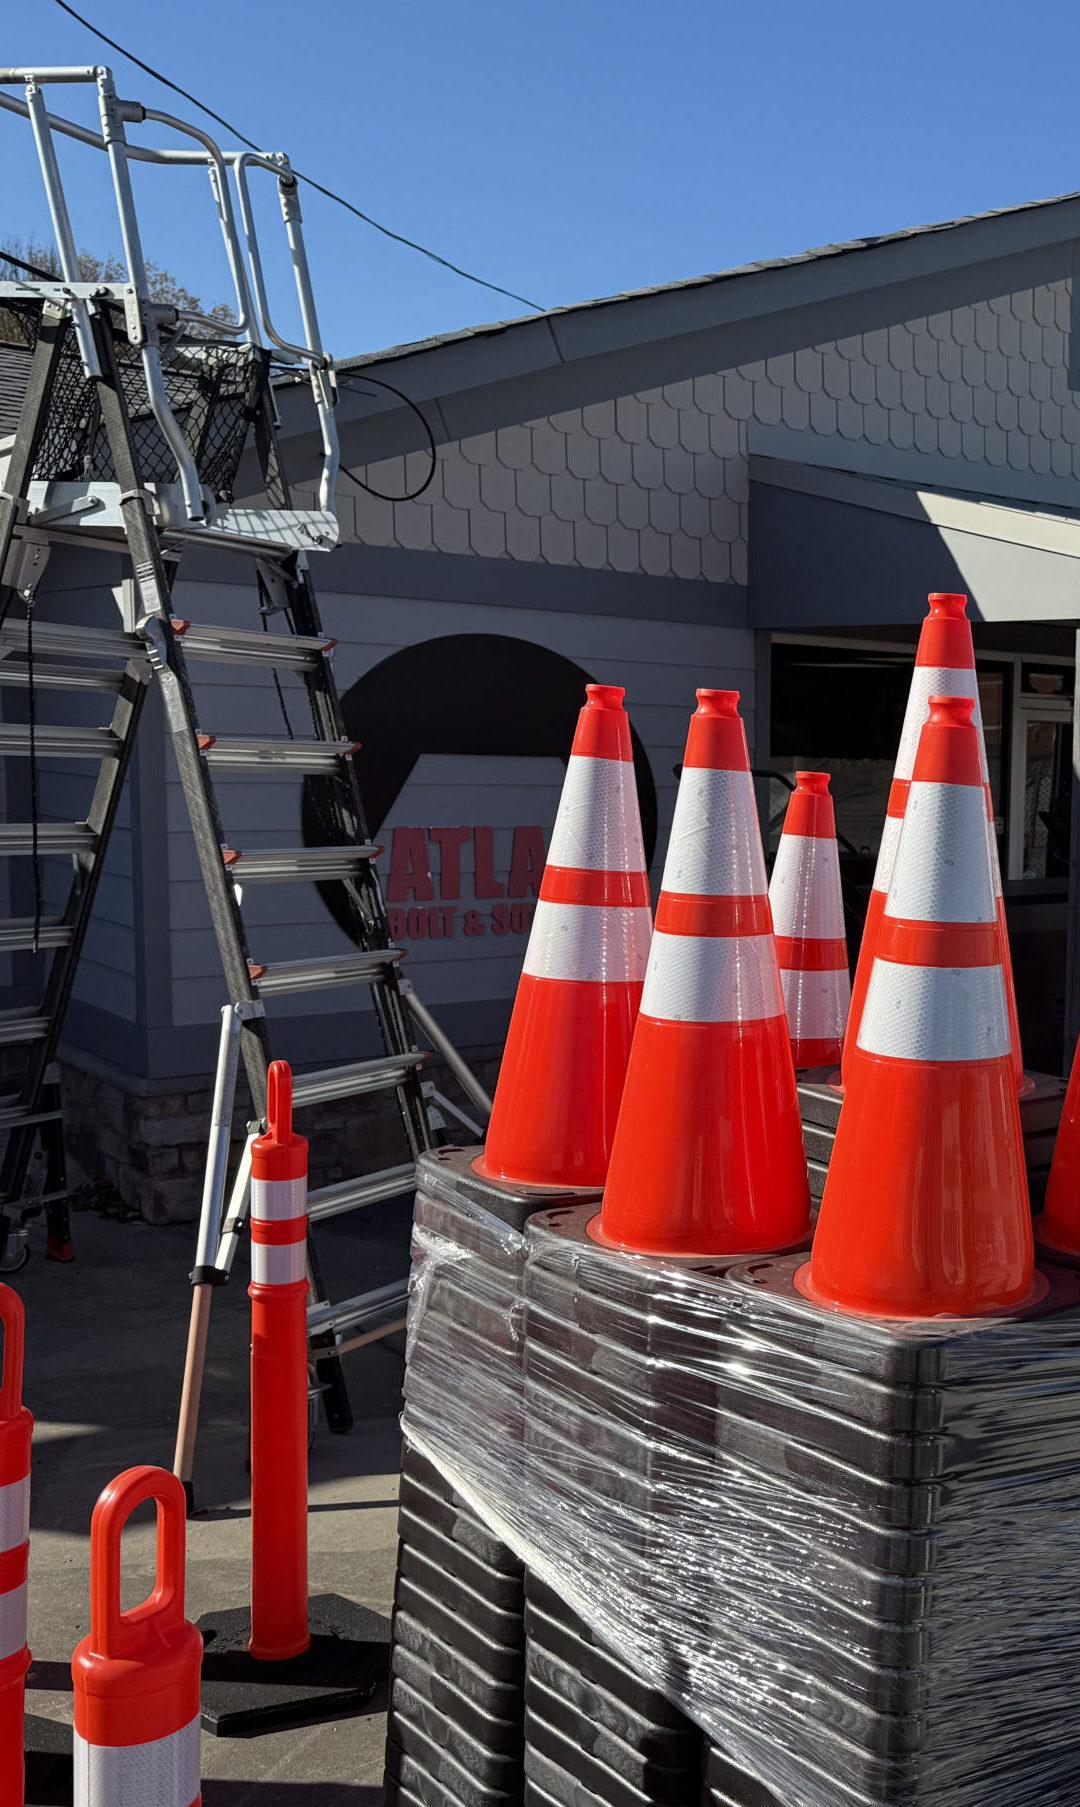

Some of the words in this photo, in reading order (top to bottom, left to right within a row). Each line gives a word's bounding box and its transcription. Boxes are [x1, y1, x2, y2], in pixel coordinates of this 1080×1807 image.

[387, 906, 458, 941] BOLT
[464, 910, 485, 937] &
[491, 903, 536, 936] SU
